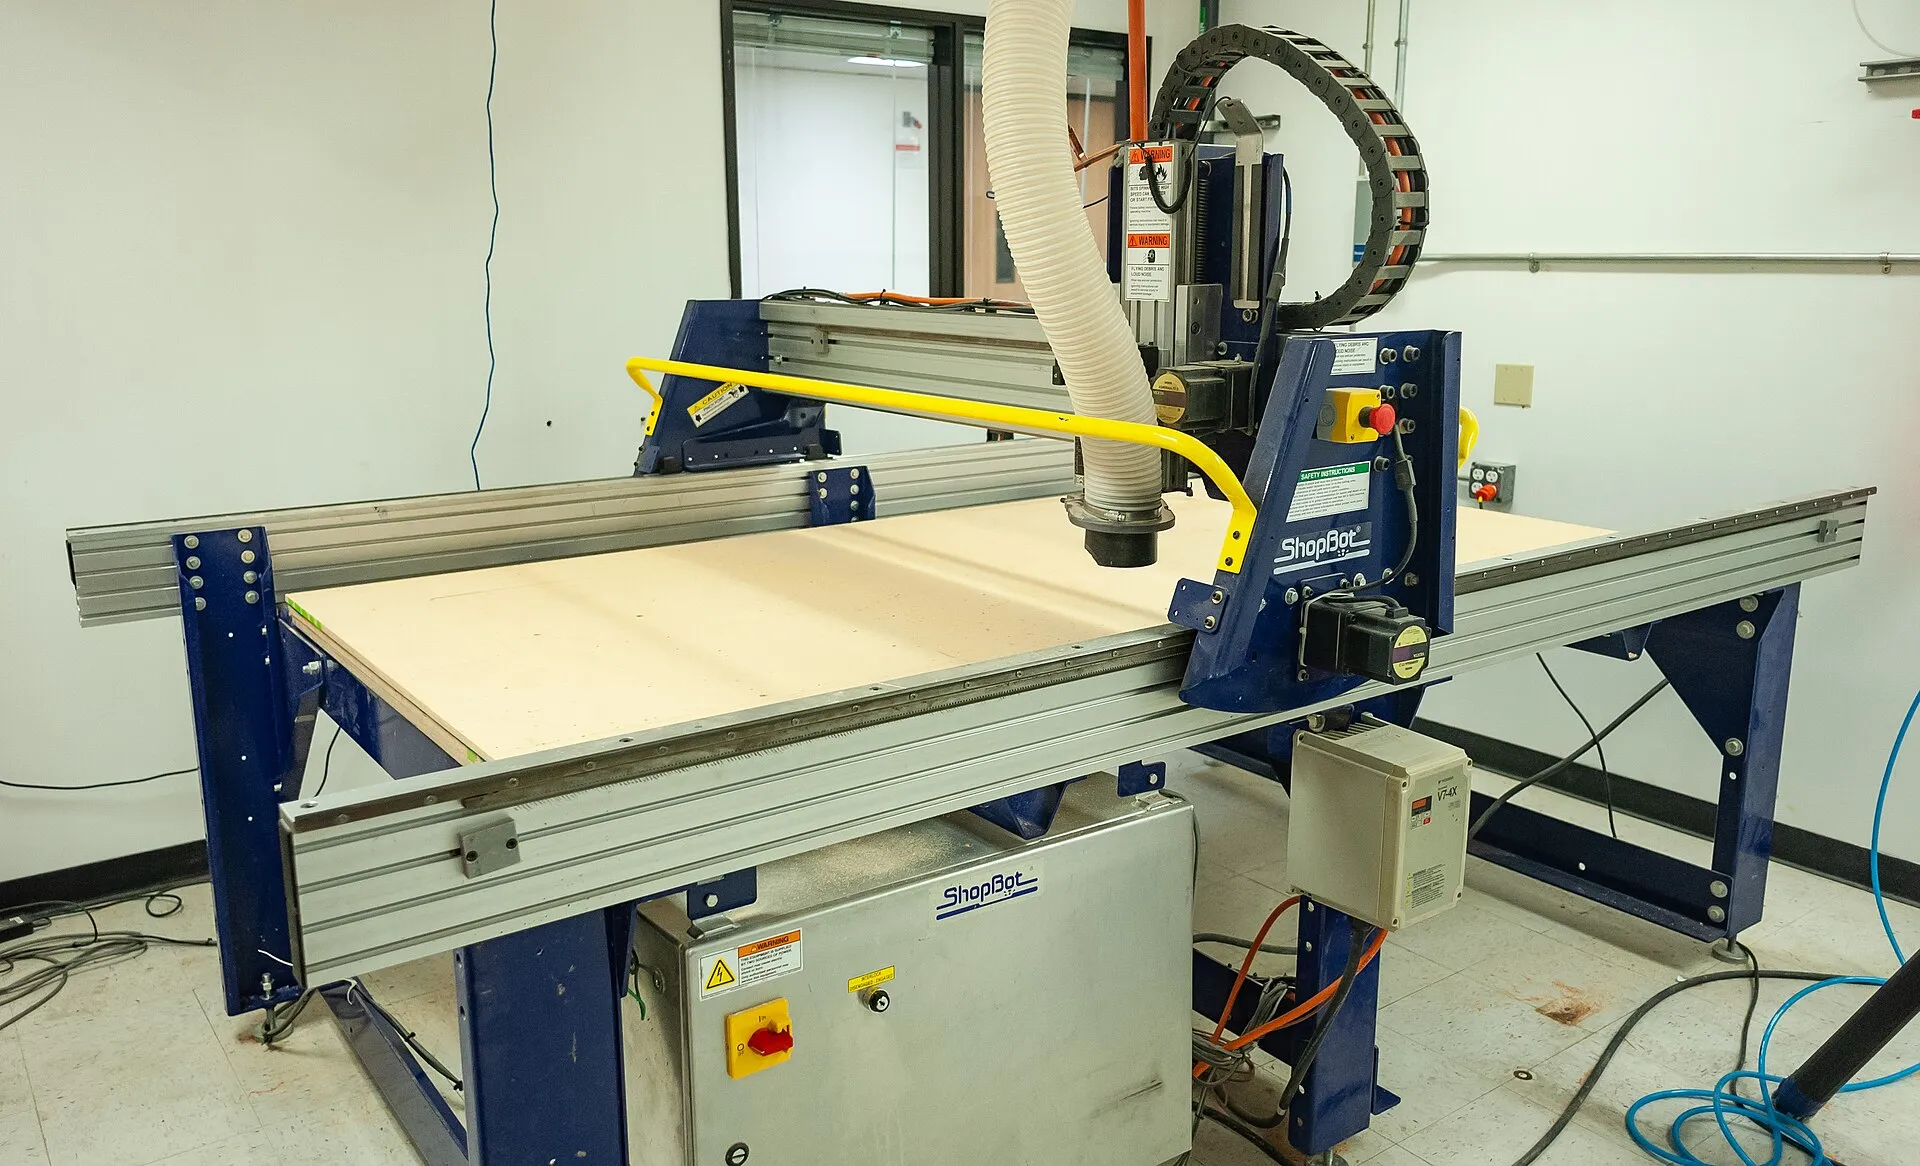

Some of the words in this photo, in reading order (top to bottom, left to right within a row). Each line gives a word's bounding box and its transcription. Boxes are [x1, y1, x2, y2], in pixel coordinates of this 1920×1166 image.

[1139, 236, 1167, 246] WARNING
[702, 382, 733, 405] CAUTION
[1300, 471, 1320, 481] SAFETY
[1321, 466, 1355, 477] INSTRUCTIONS
[936, 871, 1038, 910] ShopBot
[757, 936, 789, 950] WARNING
